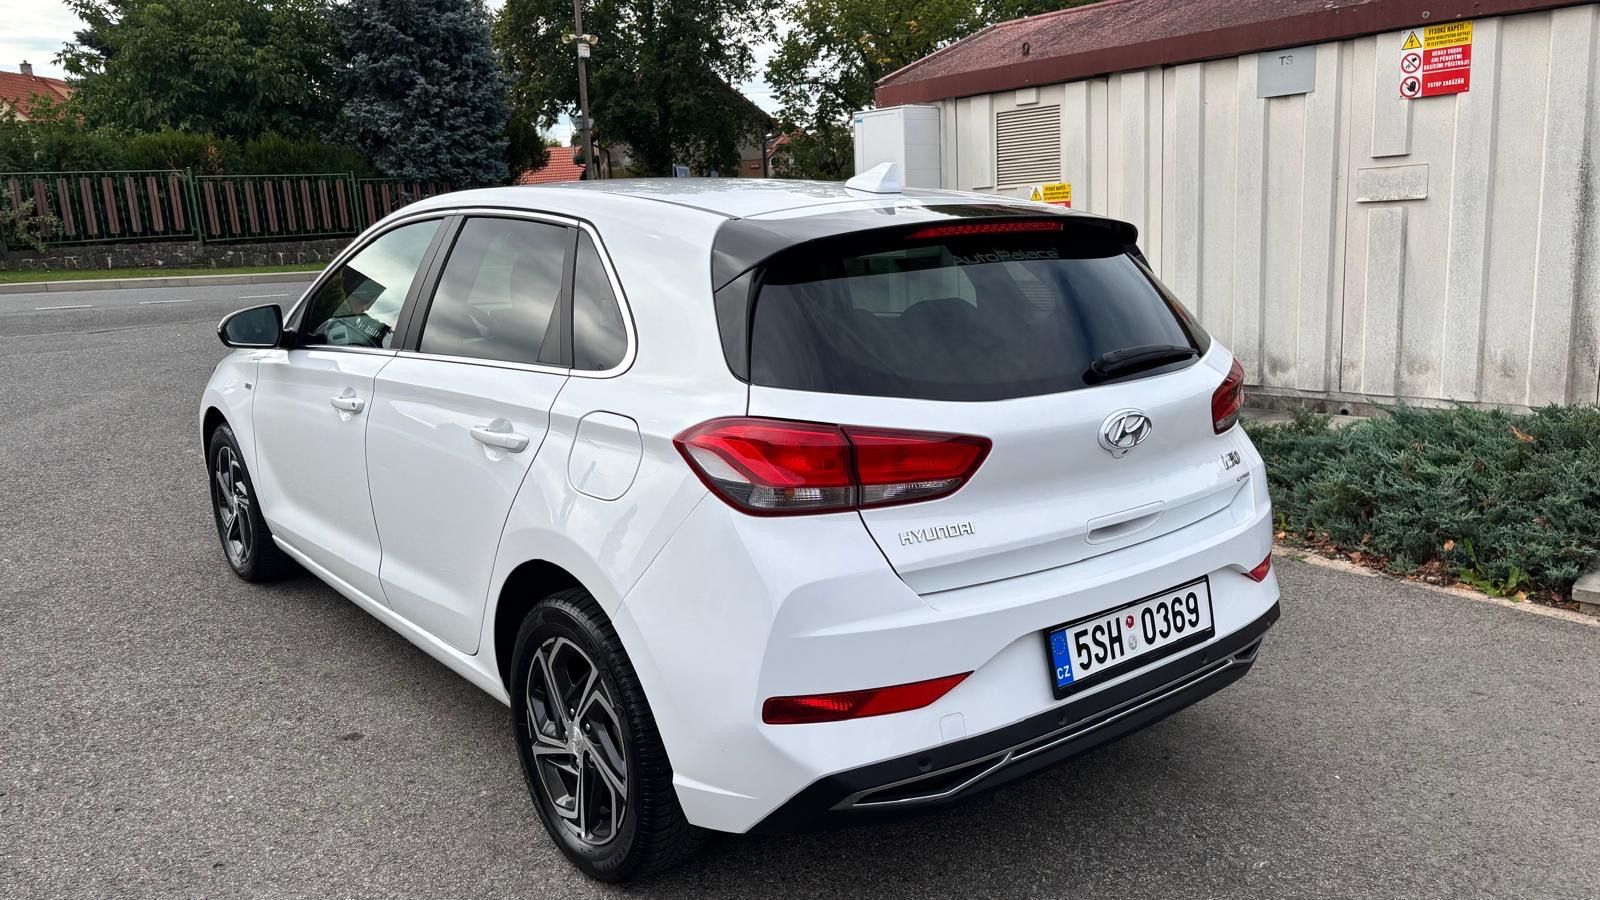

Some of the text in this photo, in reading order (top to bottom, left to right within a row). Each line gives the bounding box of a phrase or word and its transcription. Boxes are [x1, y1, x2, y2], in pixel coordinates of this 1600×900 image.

[1428, 26, 1446, 35] VYSOKÉ
[1278, 55, 1294, 66] TS
[898, 520, 975, 546] HYUNDAI
[1056, 591, 1200, 680] CZ 5SH 0369
